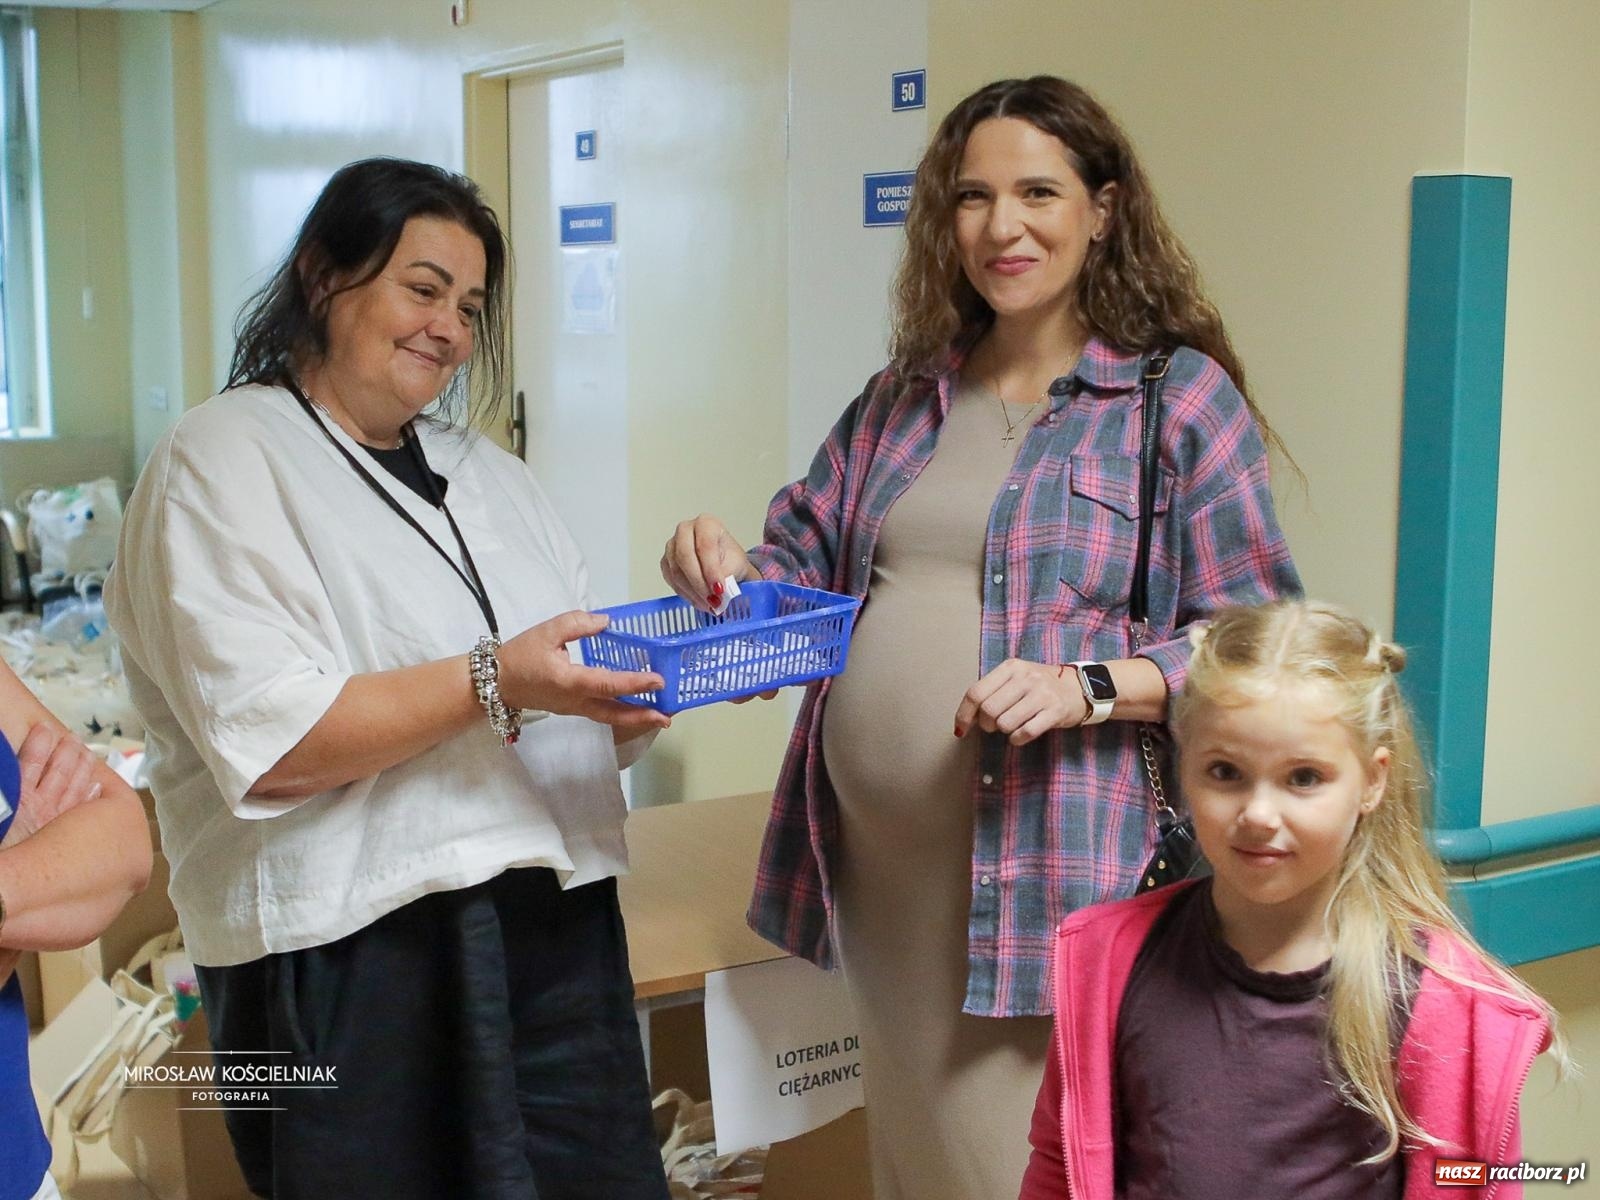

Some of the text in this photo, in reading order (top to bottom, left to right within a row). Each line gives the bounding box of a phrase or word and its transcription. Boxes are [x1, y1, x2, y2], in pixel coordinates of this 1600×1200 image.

[901, 82, 916, 102] 50
[876, 185, 912, 199] POMIESZ
[776, 1041, 840, 1069] LOTERIA
[778, 1062, 861, 1096] CIĘŻARNYC
